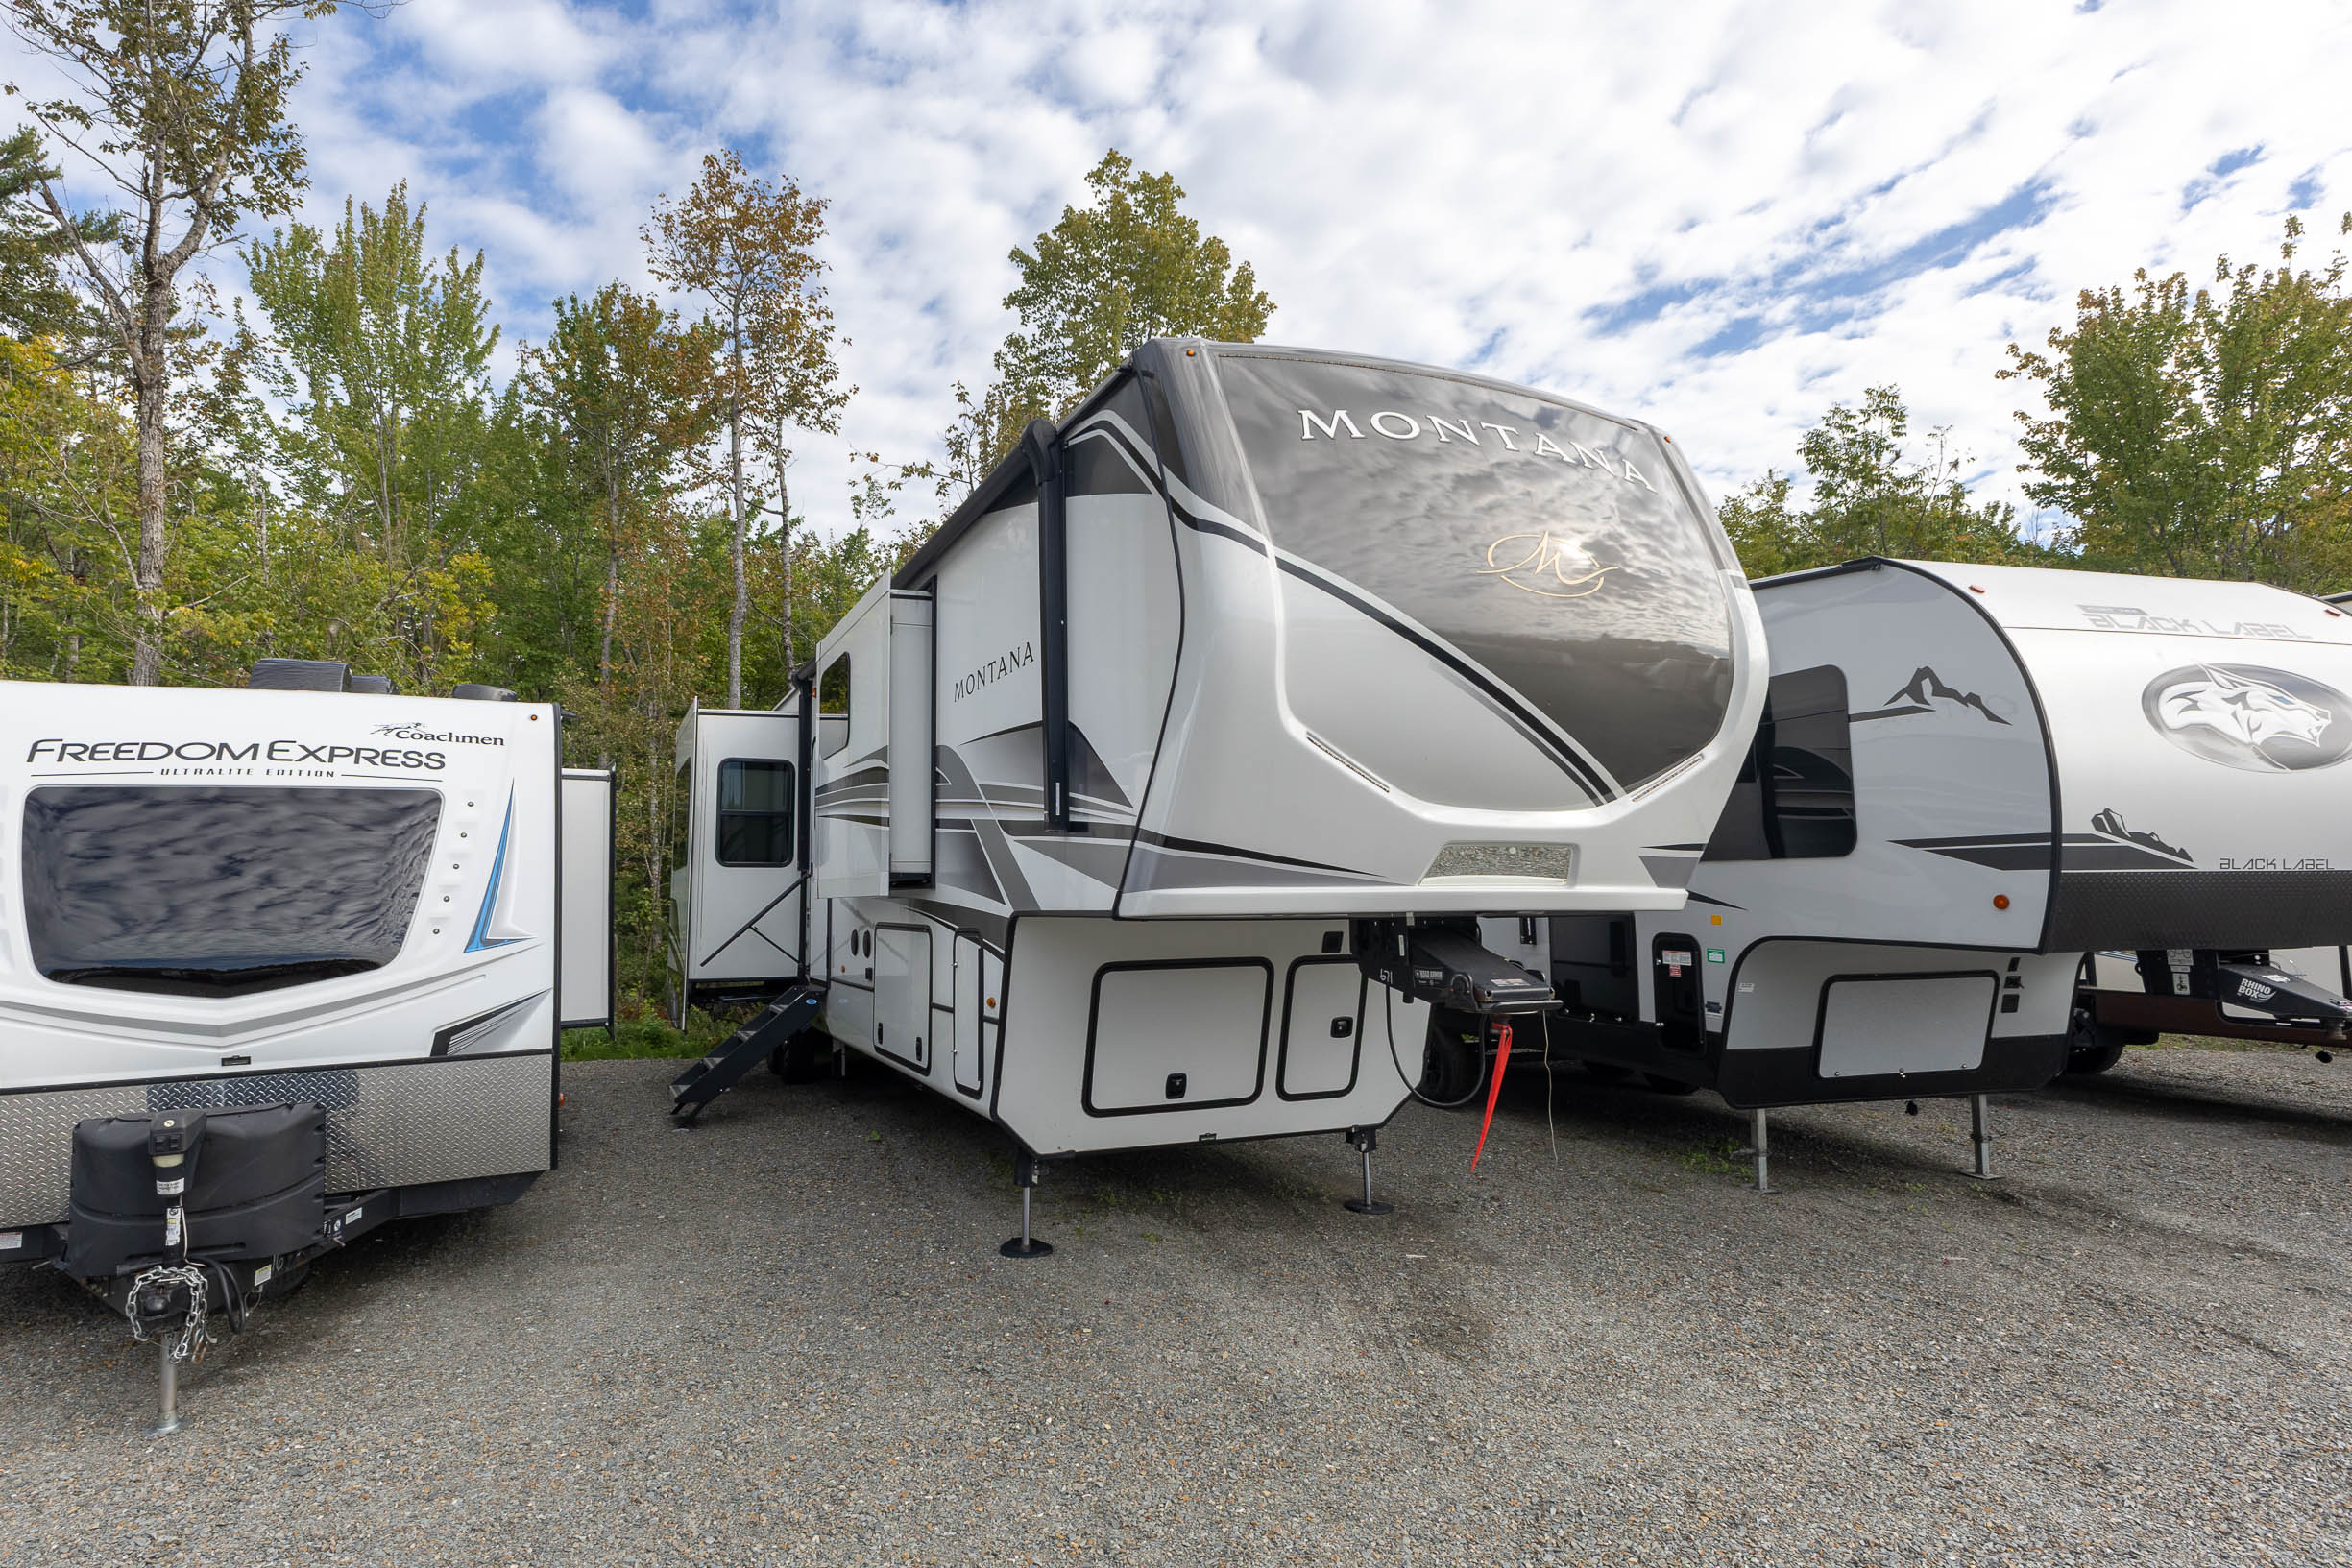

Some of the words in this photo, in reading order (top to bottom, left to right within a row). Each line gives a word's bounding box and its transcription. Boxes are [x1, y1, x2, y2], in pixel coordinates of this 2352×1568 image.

[1297, 409, 1658, 494] MONTANA
[2082, 613, 2202, 633] BLACK
[2202, 619, 2314, 639] LABEL
[954, 641, 1034, 703] MONTANA
[395, 730, 505, 746] Coachmen
[26, 738, 260, 763] FREEDOM
[266, 740, 447, 770] EXPRESS
[266, 768, 335, 778] EDITION
[2219, 857, 2277, 870] BLACK
[2283, 858, 2336, 870] LABEL
[2238, 985, 2260, 999] BOX
[2241, 977, 2272, 995] RHINO
